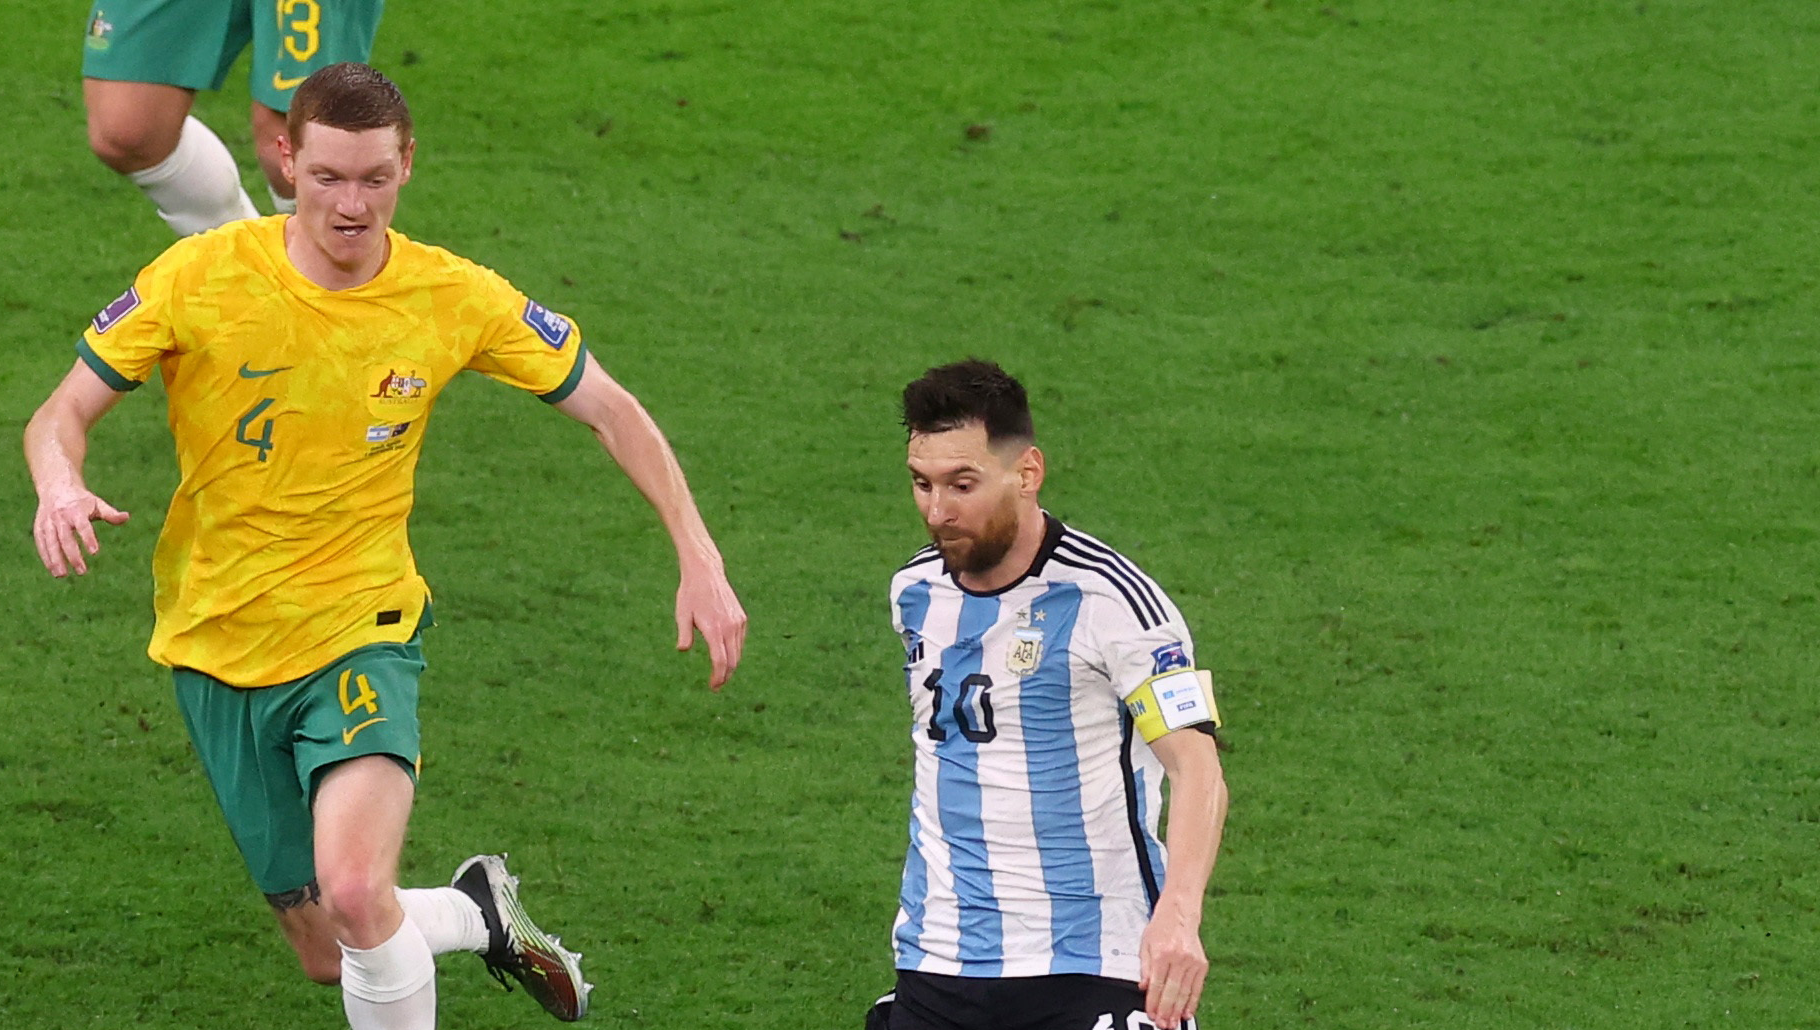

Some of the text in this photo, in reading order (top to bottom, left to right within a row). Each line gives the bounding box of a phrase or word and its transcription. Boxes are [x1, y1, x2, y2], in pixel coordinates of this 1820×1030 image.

[236, 397, 276, 463] 4
[338, 668, 378, 715] 4
[923, 668, 997, 744] 10
